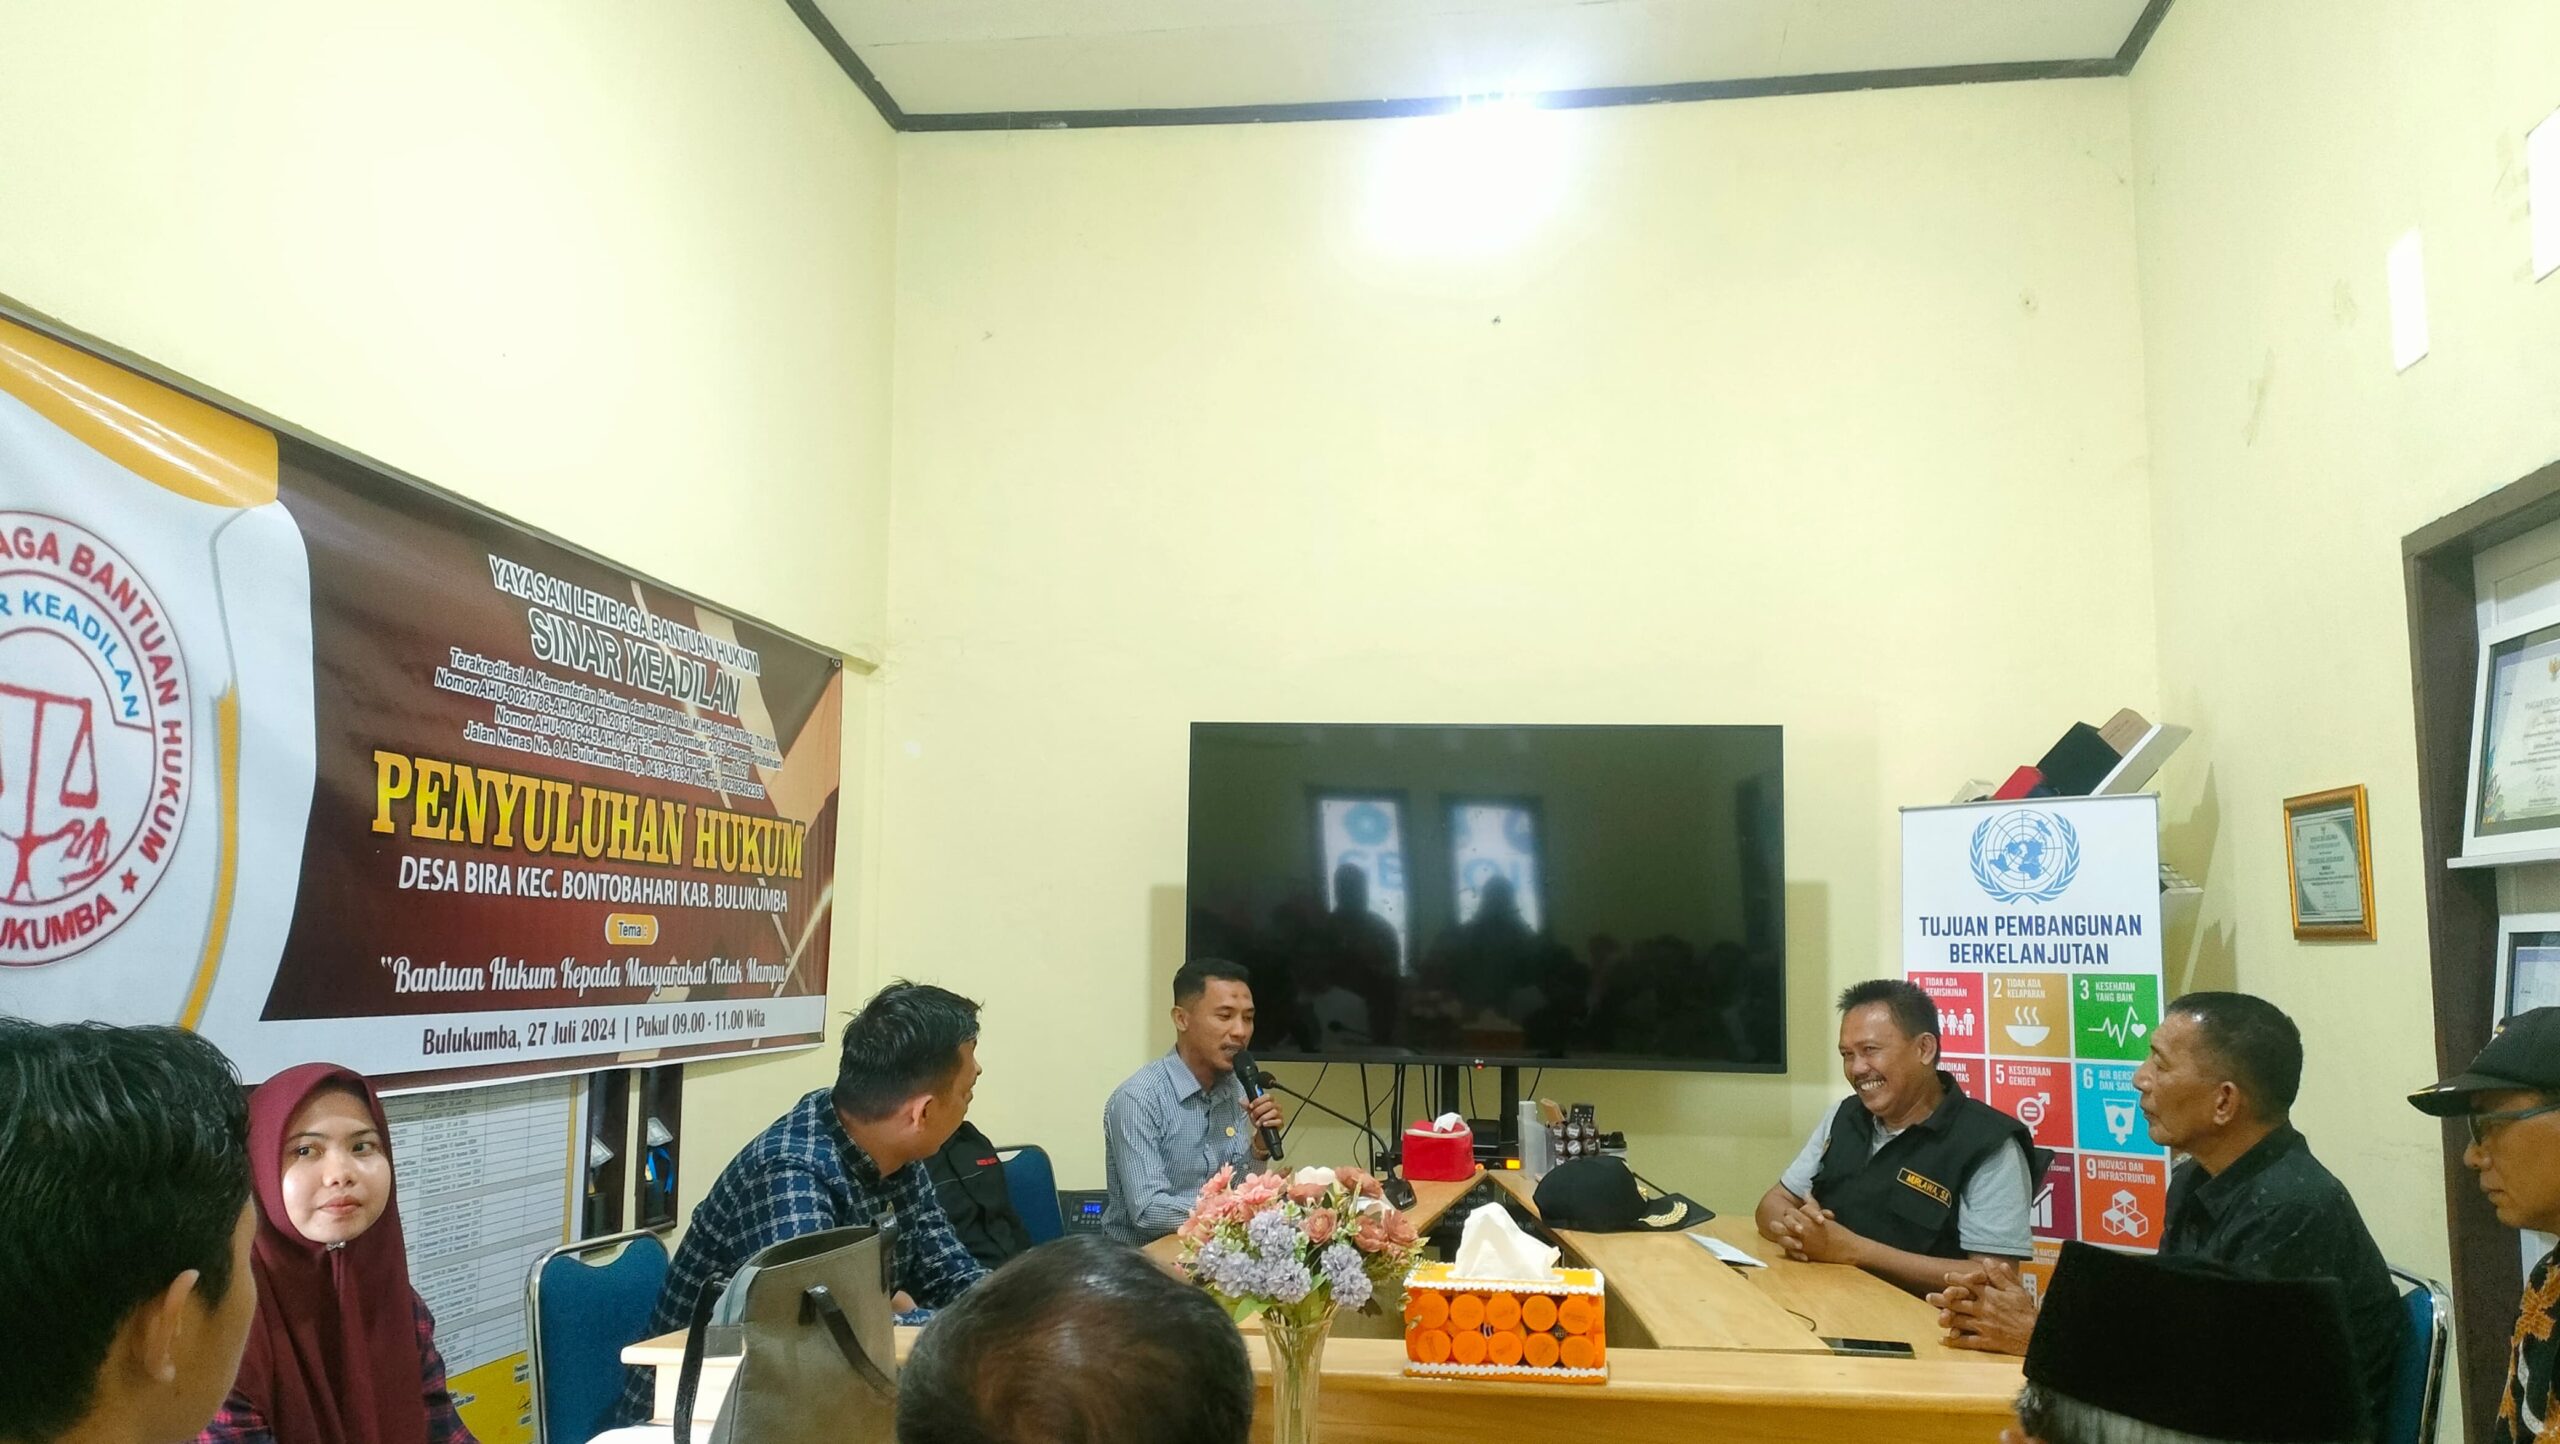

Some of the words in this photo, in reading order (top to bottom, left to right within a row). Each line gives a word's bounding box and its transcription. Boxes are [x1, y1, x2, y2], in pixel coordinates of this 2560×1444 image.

[488, 554, 571, 610] YAYASAN
[573, 586, 651, 639] LEMBAGA
[650, 614, 717, 662] BANTUAN
[717, 641, 761, 677] HUKUM
[23, 590, 139, 717] KEADILAN
[528, 607, 622, 681] SINAR
[624, 638, 741, 718] KEADILAN
[450, 647, 524, 685] Terakreditasi
[524, 668, 536, 687] A
[536, 670, 597, 704] Kementerian
[597, 688, 628, 713] Hukum
[629, 698, 646, 718] dan
[645, 702, 666, 723] HAM
[69, 543, 179, 706] BANTUAN
[138, 720, 182, 863] HUKUM
[434, 666, 478, 695] Nomor
[630, 718, 661, 742] tanggal
[661, 726, 668, 743] 9
[668, 727, 707, 752] November
[708, 739, 727, 757] 2015
[463, 720, 496, 745] Jalan
[497, 727, 532, 751] Nenas
[534, 735, 553, 756] No.
[553, 739, 561, 758] 8
[561, 740, 571, 760] A
[571, 742, 623, 770] Bulukumba
[624, 754, 645, 777] Telp.
[495, 705, 533, 731] Nomor
[639, 738, 664, 761] Tahun
[664, 744, 684, 765] 2021
[684, 750, 712, 773] tanggal
[371, 750, 688, 867] PENYULUHAN
[692, 806, 807, 879] HUKUM
[398, 855, 459, 893] DESA
[464, 862, 513, 896] BIRA
[516, 866, 559, 899] KEC.
[561, 870, 679, 905] BONTOBAHARI
[680, 881, 712, 908] KAB.
[714, 884, 788, 913] BULUKUMBA
[0, 893, 117, 950] KUMBA
[617, 920, 642, 938] Tema
[1919, 916, 1988, 937] TUJUAN
[1995, 914, 2142, 937] PEMBANGUNAN
[1950, 943, 2109, 965] BERKELANJUTAN
[489, 956, 557, 991] Hukum
[560, 956, 620, 998] Kepada
[625, 957, 708, 996] Masyarakat
[708, 957, 744, 985] Tidak
[1925, 976, 1944, 987] TIDAK
[1945, 976, 1958, 987] ADA
[2006, 978, 2026, 988] TIDAK
[2027, 978, 2042, 988] ADA
[2095, 981, 2136, 992] KESEHATAN
[1993, 978, 2002, 998] 2
[2007, 989, 2046, 998] KELAPARAN
[2079, 979, 2090, 1000] 3
[2095, 992, 2115, 1002] YANG
[2116, 992, 2134, 1002] BAIK
[423, 1025, 521, 1055] Bulukumba,
[527, 1022, 548, 1047] 27
[551, 1020, 577, 1045] Juli
[581, 1018, 616, 1042] 2024
[636, 1014, 669, 1038] Pukul
[672, 1012, 705, 1035] 09.00
[715, 1010, 743, 1032] 11.00
[746, 1009, 765, 1029] Wita
[1995, 1064, 2005, 1084] 5
[2008, 1065, 2052, 1077] KESETARAAN
[2008, 1076, 2036, 1086] GENDER
[2083, 1068, 2094, 1089] 6
[2099, 1069, 2111, 1079] AIR
[2099, 1080, 2114, 1090] DAN
[2086, 1157, 2097, 1180] 9
[2097, 1159, 2127, 1171] INOVASI
[2128, 1161, 2144, 1172] DAN
[2097, 1170, 2156, 1184] INFRASTRUKTUR
